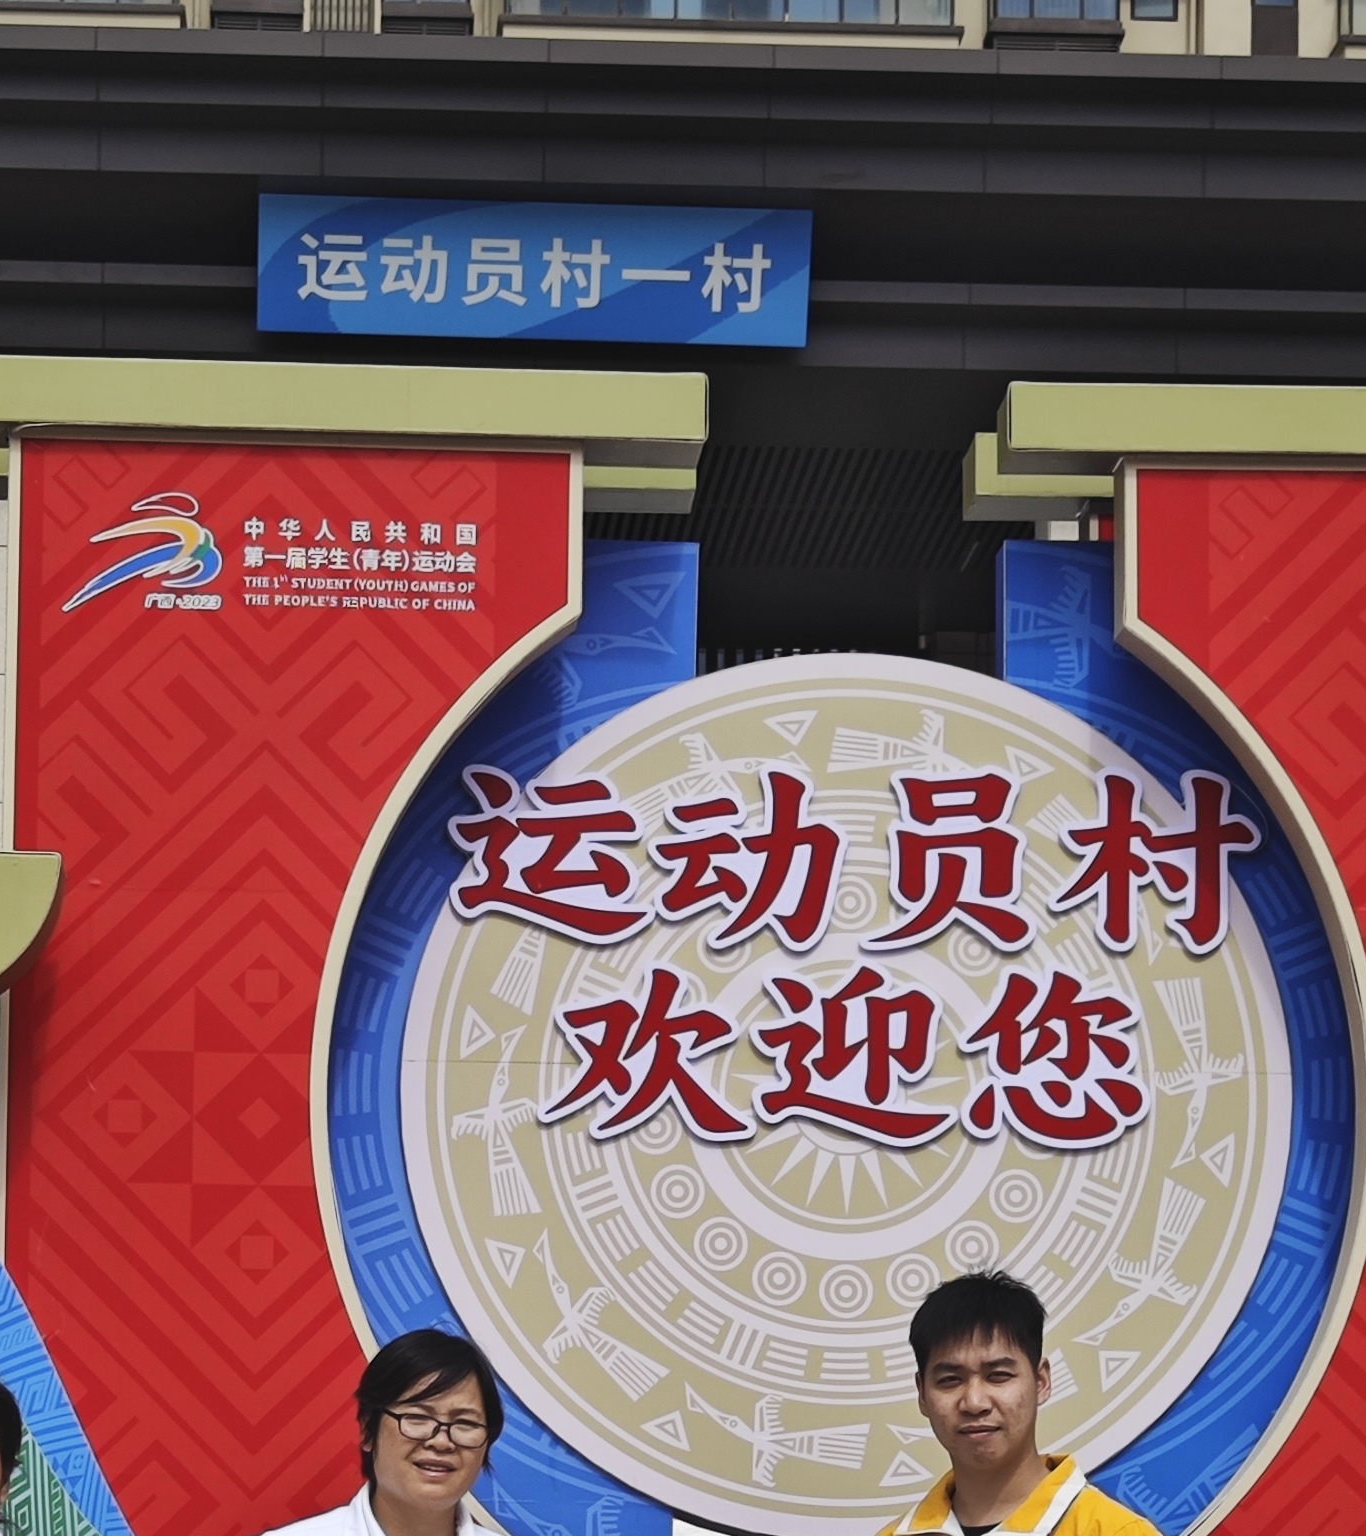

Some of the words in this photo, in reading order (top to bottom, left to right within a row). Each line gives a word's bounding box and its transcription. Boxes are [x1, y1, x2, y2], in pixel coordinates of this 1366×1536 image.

[296, 233, 772, 314] 运动员村一村
[243, 516, 477, 546] 中华人民共和国
[243, 546, 476, 573] 第一届学生(青年)运动会
[243, 576, 269, 589] THE
[291, 577, 351, 591] STUDENT
[354, 579, 408, 593] (YOUTH)
[411, 581, 454, 593] GAMES
[458, 581, 476, 594] OF
[243, 594, 269, 606] THE
[274, 594, 338, 608] PEOPLE'S
[342, 596, 407, 610] REPUBLIC
[412, 598, 429, 610] OF
[434, 597, 476, 612] CHINA
[450, 768, 1265, 953] 运动员村
[540, 967, 1148, 1146] 欢迎您
